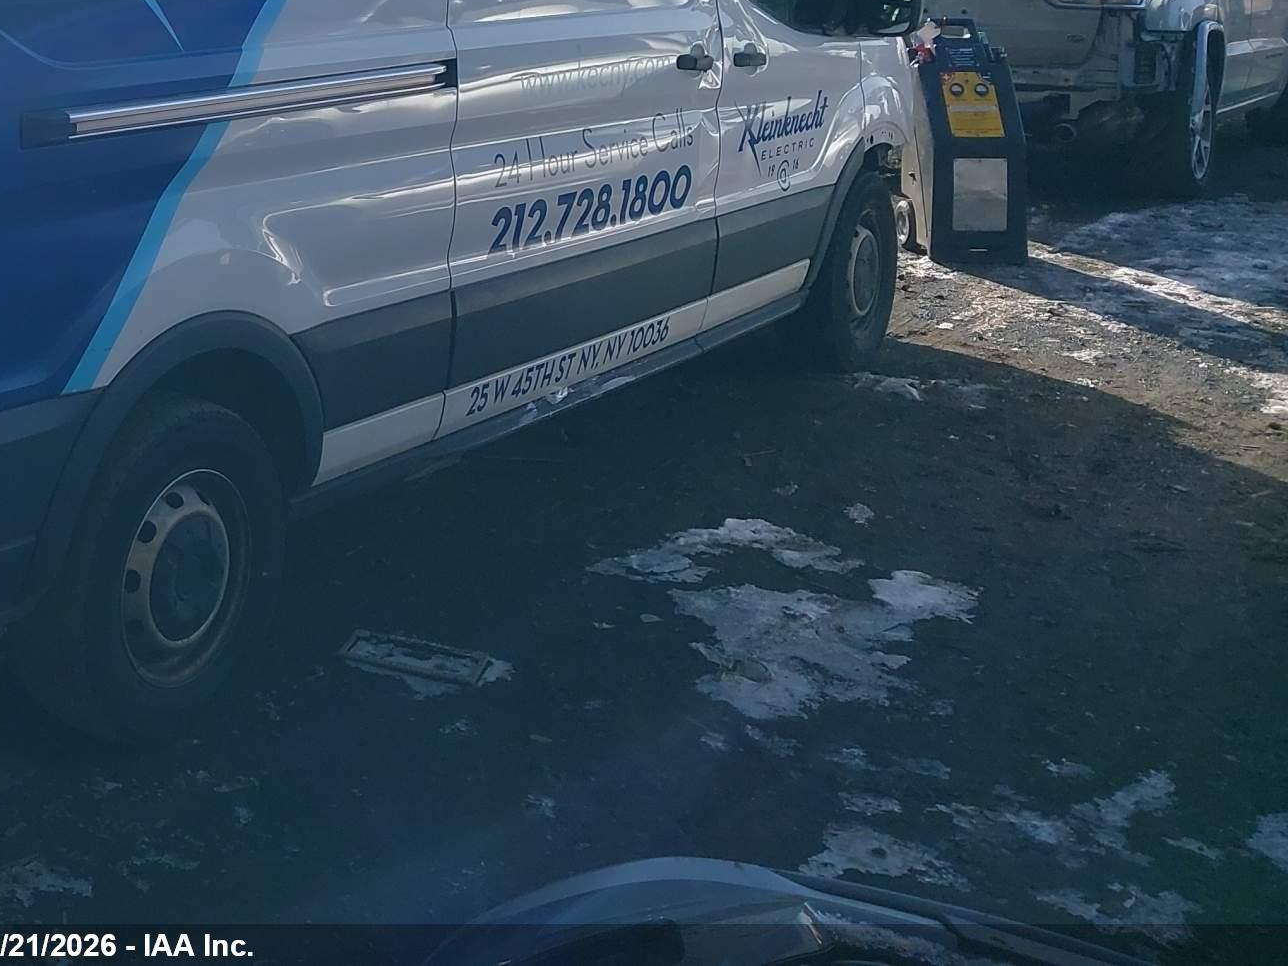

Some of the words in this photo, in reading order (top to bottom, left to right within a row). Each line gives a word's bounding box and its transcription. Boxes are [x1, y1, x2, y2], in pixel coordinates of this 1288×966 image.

[494, 151, 521, 188] 24
[525, 136, 578, 182] Hour
[582, 128, 649, 169] Service
[652, 108, 694, 153] Calls
[738, 89, 828, 153] Kleinknecht
[761, 137, 815, 161] ELECTRIC
[488, 164, 692, 255] 212.728.1800
[466, 383, 490, 417] 25
[492, 375, 512, 404] W
[512, 358, 555, 399] 45TH
[554, 351, 577, 384] ST
[602, 332, 628, 365] NY
[626, 316, 672, 355] 10036
